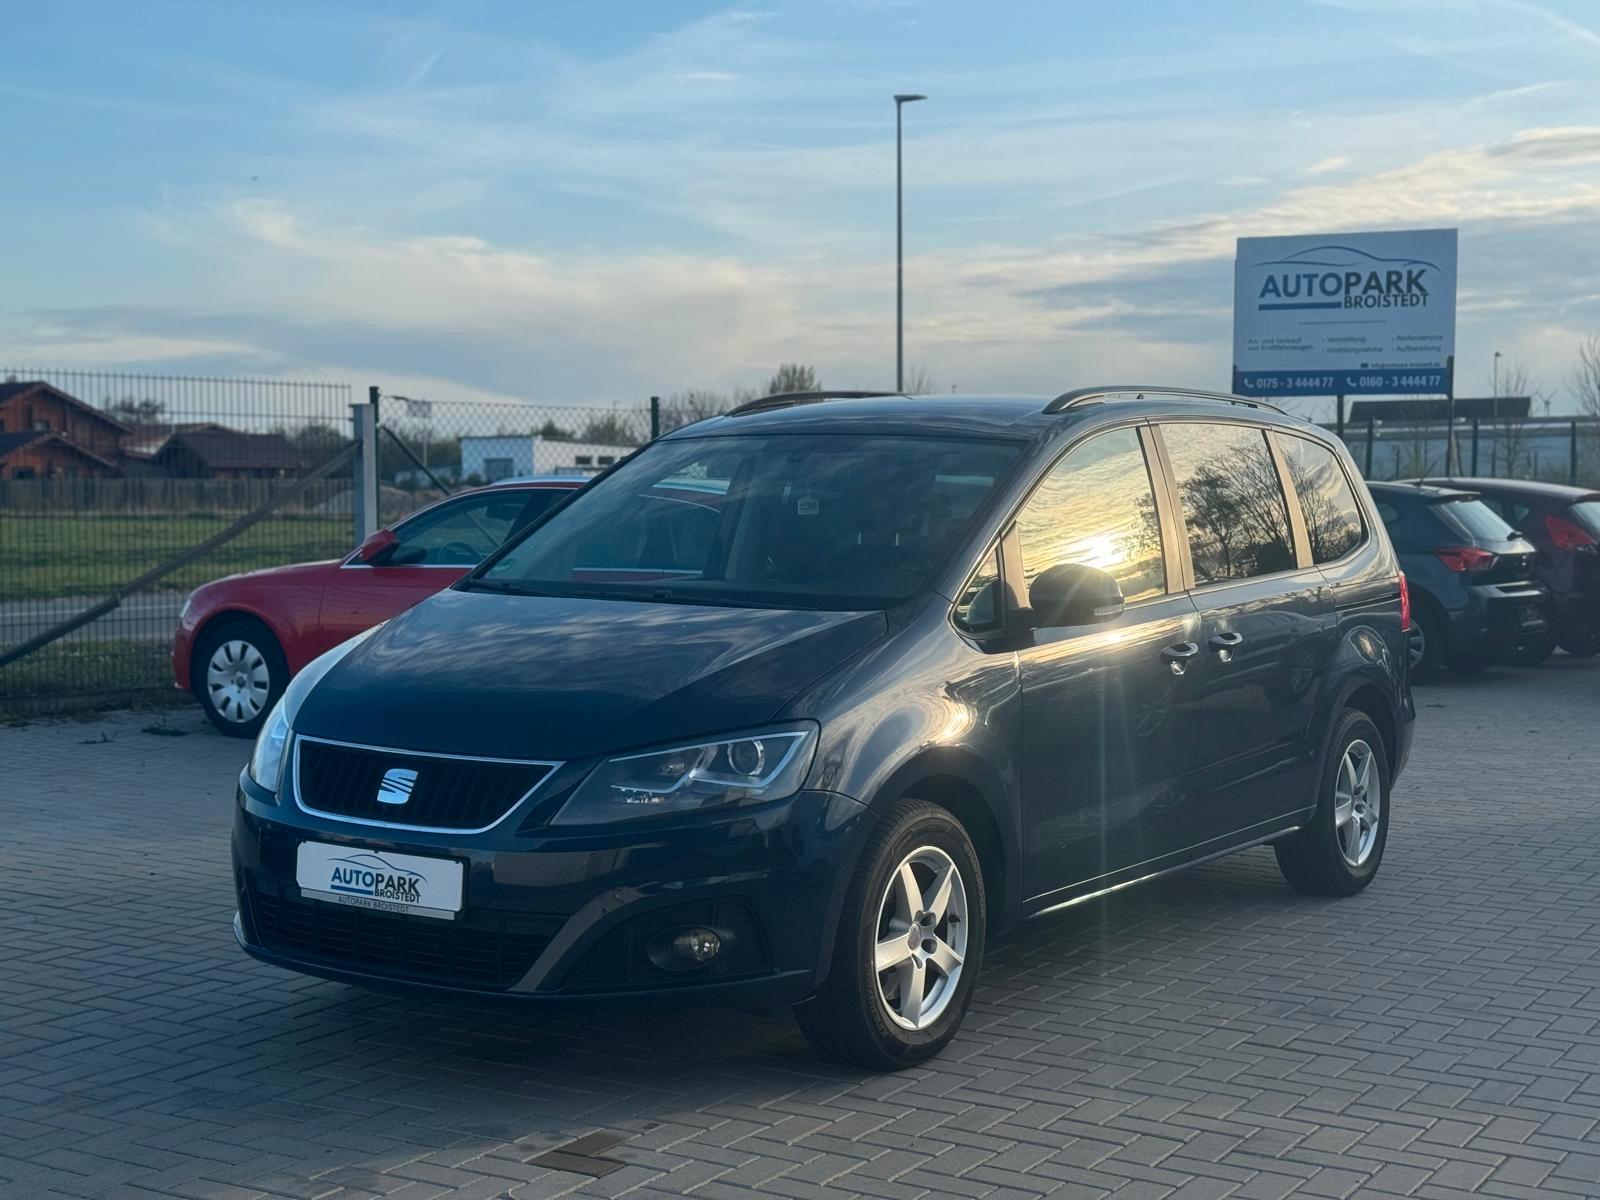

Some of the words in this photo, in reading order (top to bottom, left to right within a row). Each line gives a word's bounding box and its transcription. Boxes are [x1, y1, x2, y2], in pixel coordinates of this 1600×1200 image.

[1259, 269, 1428, 298] AUTOPARK
[1344, 293, 1429, 309] BROISTEDT
[1256, 377, 1278, 388] 0175
[1360, 376, 1383, 387] 0160
[331, 867, 421, 896] AUTOPARK
[338, 896, 372, 907] AUTOPARK
[373, 900, 409, 912] BROISTEDT
[374, 889, 421, 903] BROISTEDT
